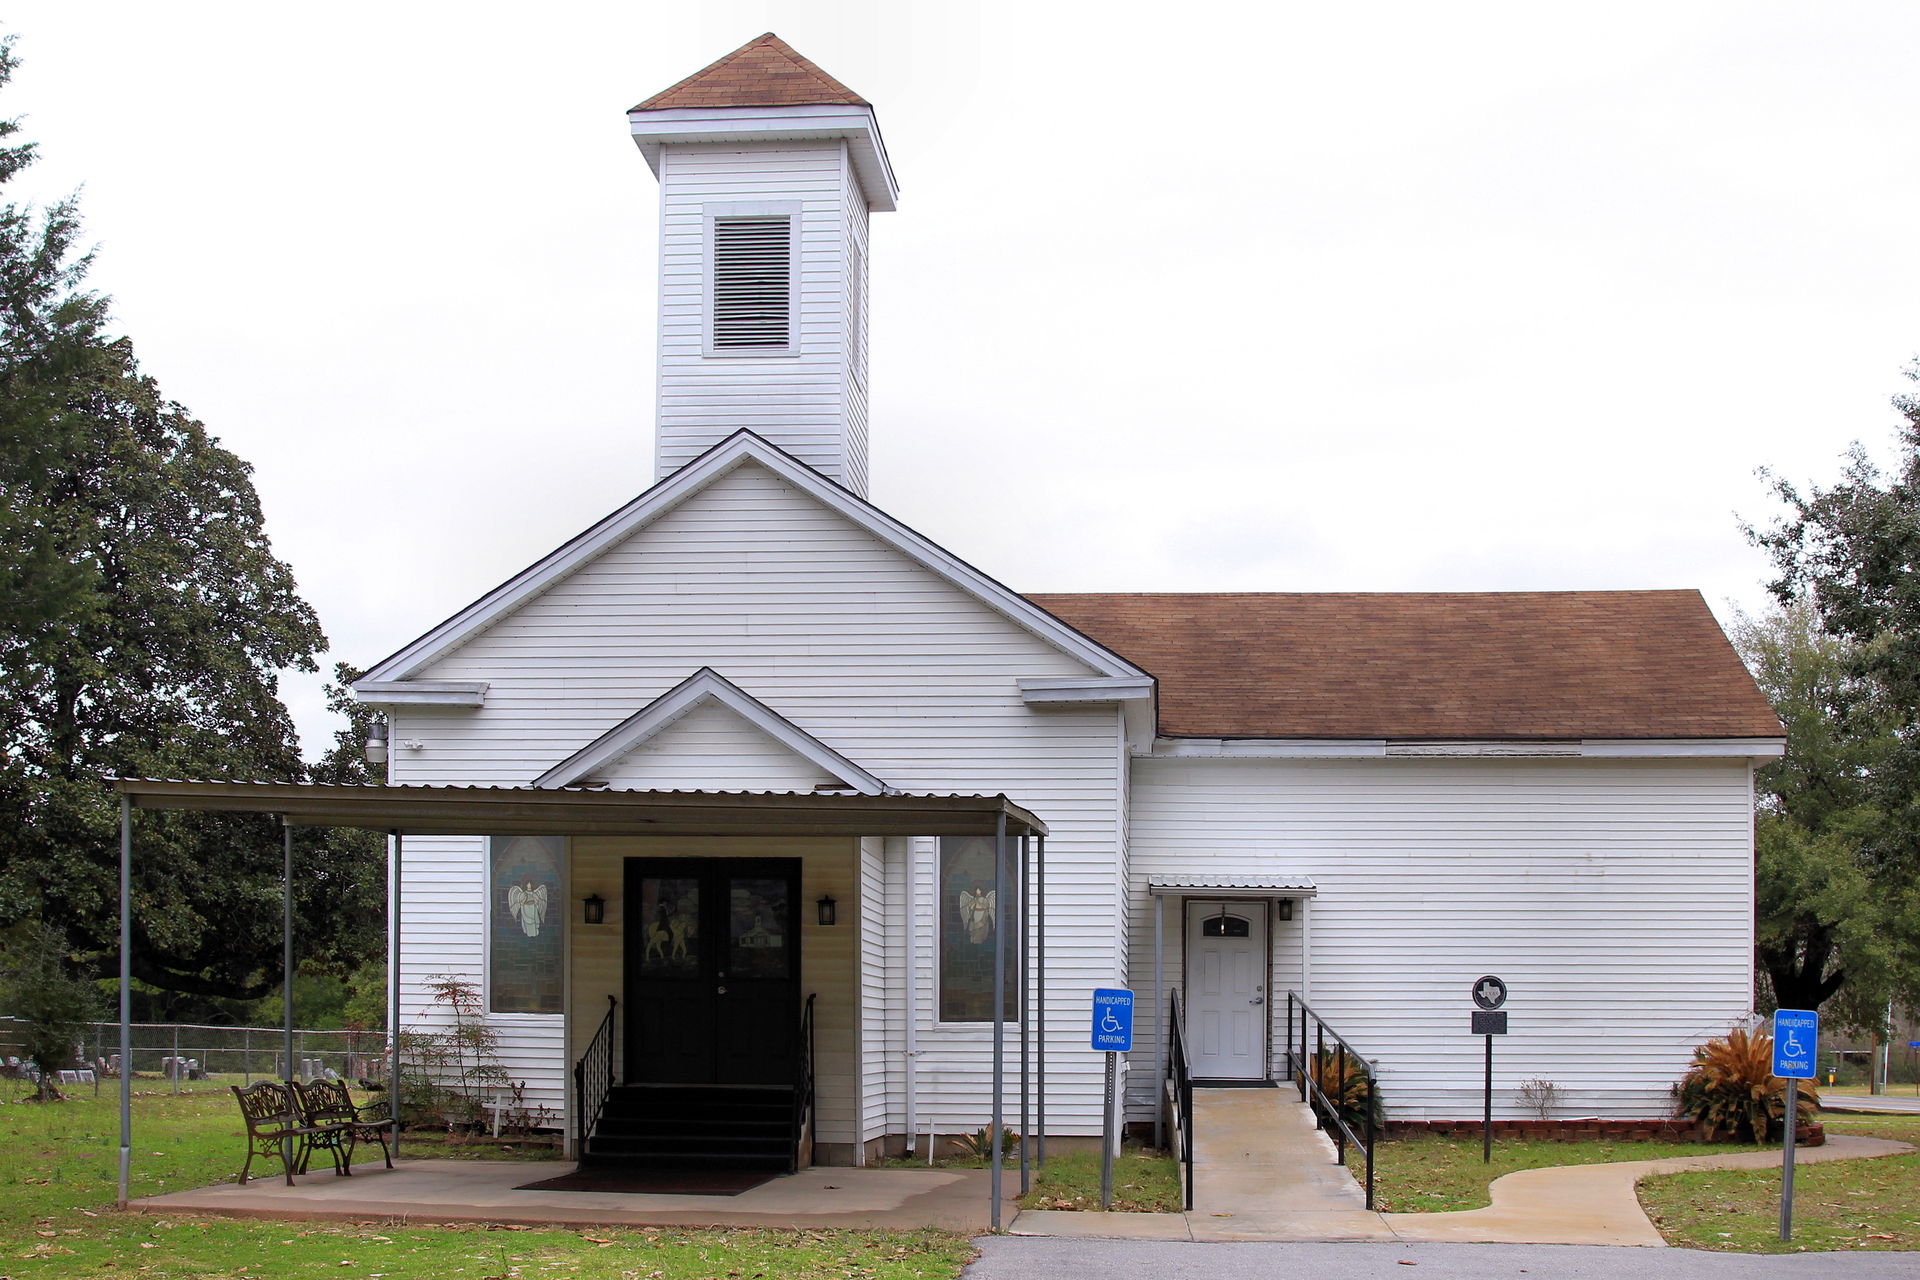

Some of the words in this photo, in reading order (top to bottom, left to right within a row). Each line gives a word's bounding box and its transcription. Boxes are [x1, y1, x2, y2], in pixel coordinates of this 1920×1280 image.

[1096, 996, 1131, 1006] HANDICAPPED
[1778, 1018, 1815, 1028] HANDICAPPED
[1098, 1035, 1125, 1044] PARKING
[1780, 1060, 1808, 1070] PARKING
